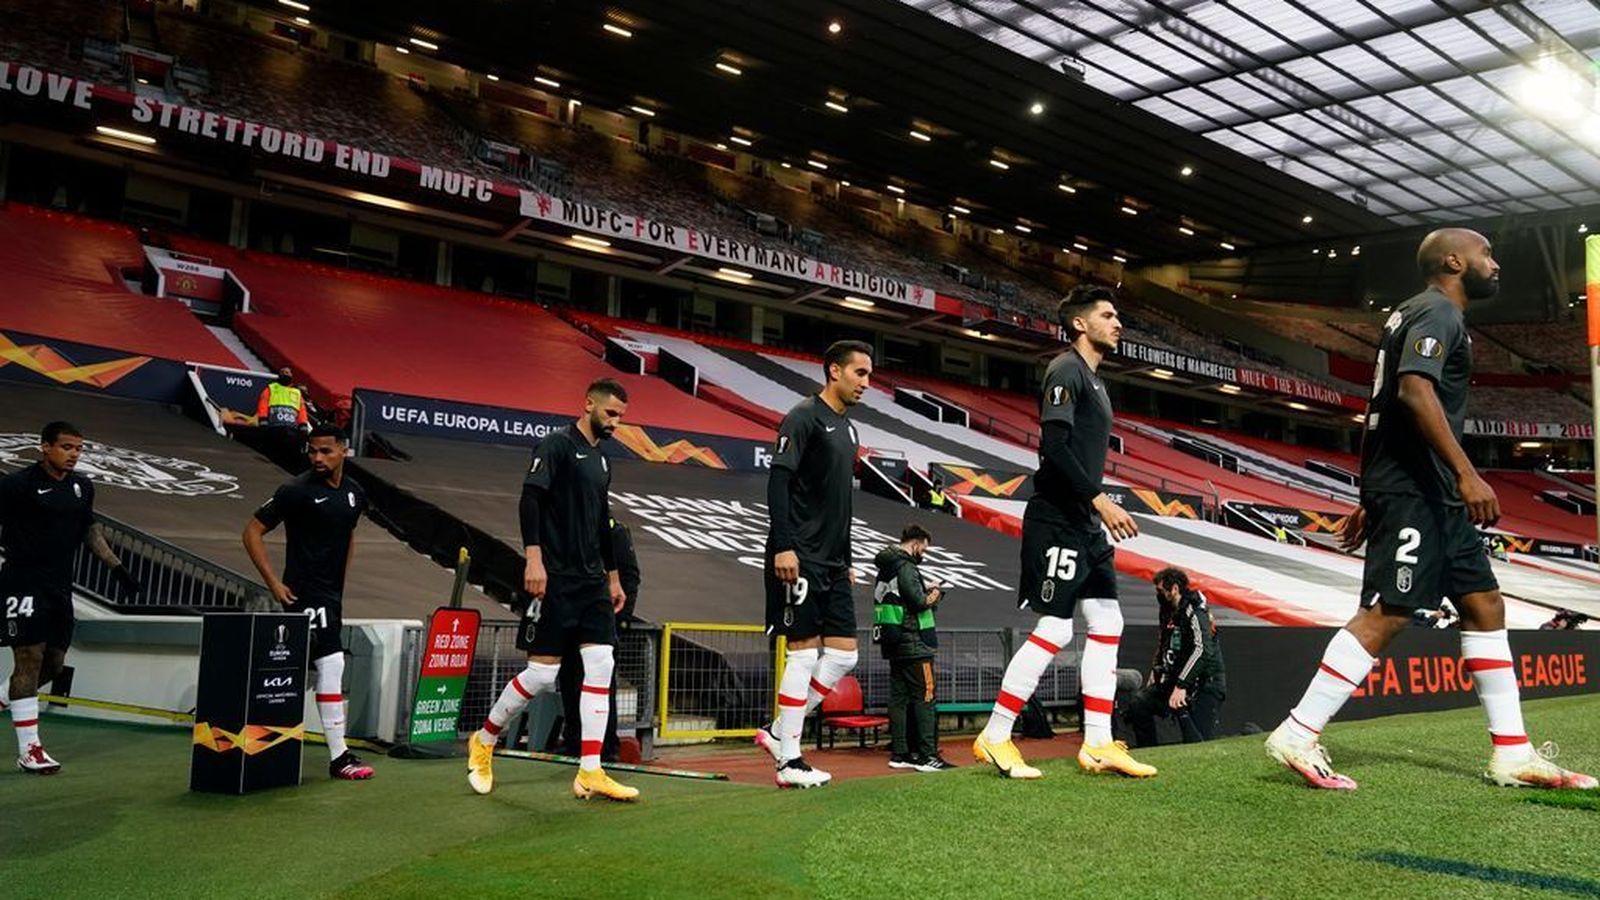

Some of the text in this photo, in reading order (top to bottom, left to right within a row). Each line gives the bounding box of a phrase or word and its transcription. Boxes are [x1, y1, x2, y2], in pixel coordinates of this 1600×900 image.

[0, 61, 494, 203] LOVE STRETFORD END MUFC
[1138, 345, 1176, 368] FLOWERS
[1187, 358, 1237, 382] MANCHESTER
[1240, 368, 1343, 405] MUFC THE RELIGION
[381, 405, 562, 439] UEFA EUROPA LEAG
[753, 445, 773, 469] Fe
[1395, 527, 1421, 564] 2
[1045, 546, 1079, 581] 15
[6, 595, 34, 619] 24
[304, 606, 328, 629] 21
[434, 635, 471, 649] RED ZONE
[428, 654, 468, 668] ZONA ROJA
[1351, 657, 1402, 698] FA
[1408, 656, 1474, 694] EURO
[415, 699, 461, 715] GREEN ZONE
[412, 717, 458, 735] ZONA VERDE
